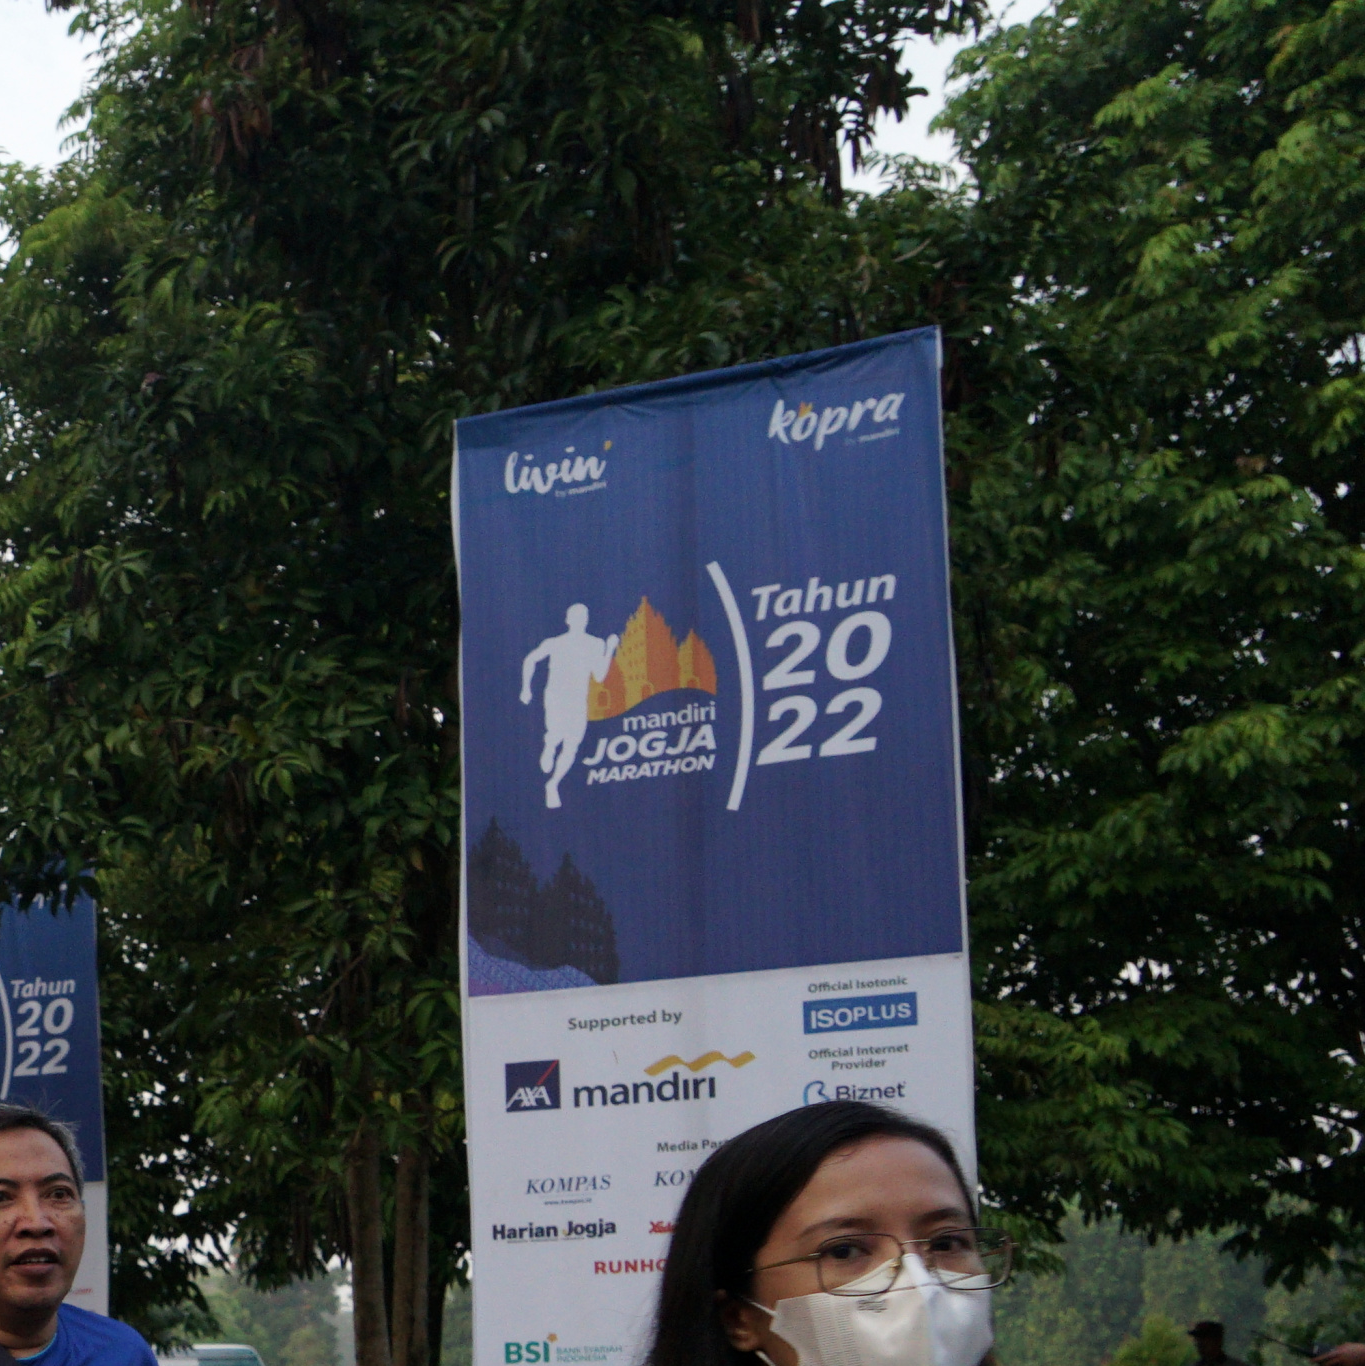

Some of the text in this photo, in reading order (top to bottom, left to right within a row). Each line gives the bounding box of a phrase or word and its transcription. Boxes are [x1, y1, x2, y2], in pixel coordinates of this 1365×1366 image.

[768, 392, 905, 451] kopra
[751, 573, 897, 621] Tahun
[762, 610, 893, 691] 20
[622, 700, 716, 733] mandiri
[756, 687, 883, 766] 22
[582, 723, 718, 766] JOGJA
[587, 754, 716, 785] MARATHON
[10, 977, 76, 999] Tahun
[807, 975, 909, 994] Official Isotonic
[15, 998, 74, 1037] 20
[568, 1008, 683, 1031] Supported by
[810, 1002, 912, 1029] ISOPLUS
[13, 1038, 70, 1077] 22
[808, 1043, 910, 1060] Official Internet
[831, 1058, 887, 1071] Provider
[505, 1071, 717, 1108] AXA mandiri
[835, 1083, 906, 1101] Biznet
[656, 1139, 699, 1153] Media
[525, 1174, 612, 1196] KOMPAS
[492, 1218, 617, 1241] Harian Jogja
[504, 1341, 551, 1364] BSI
